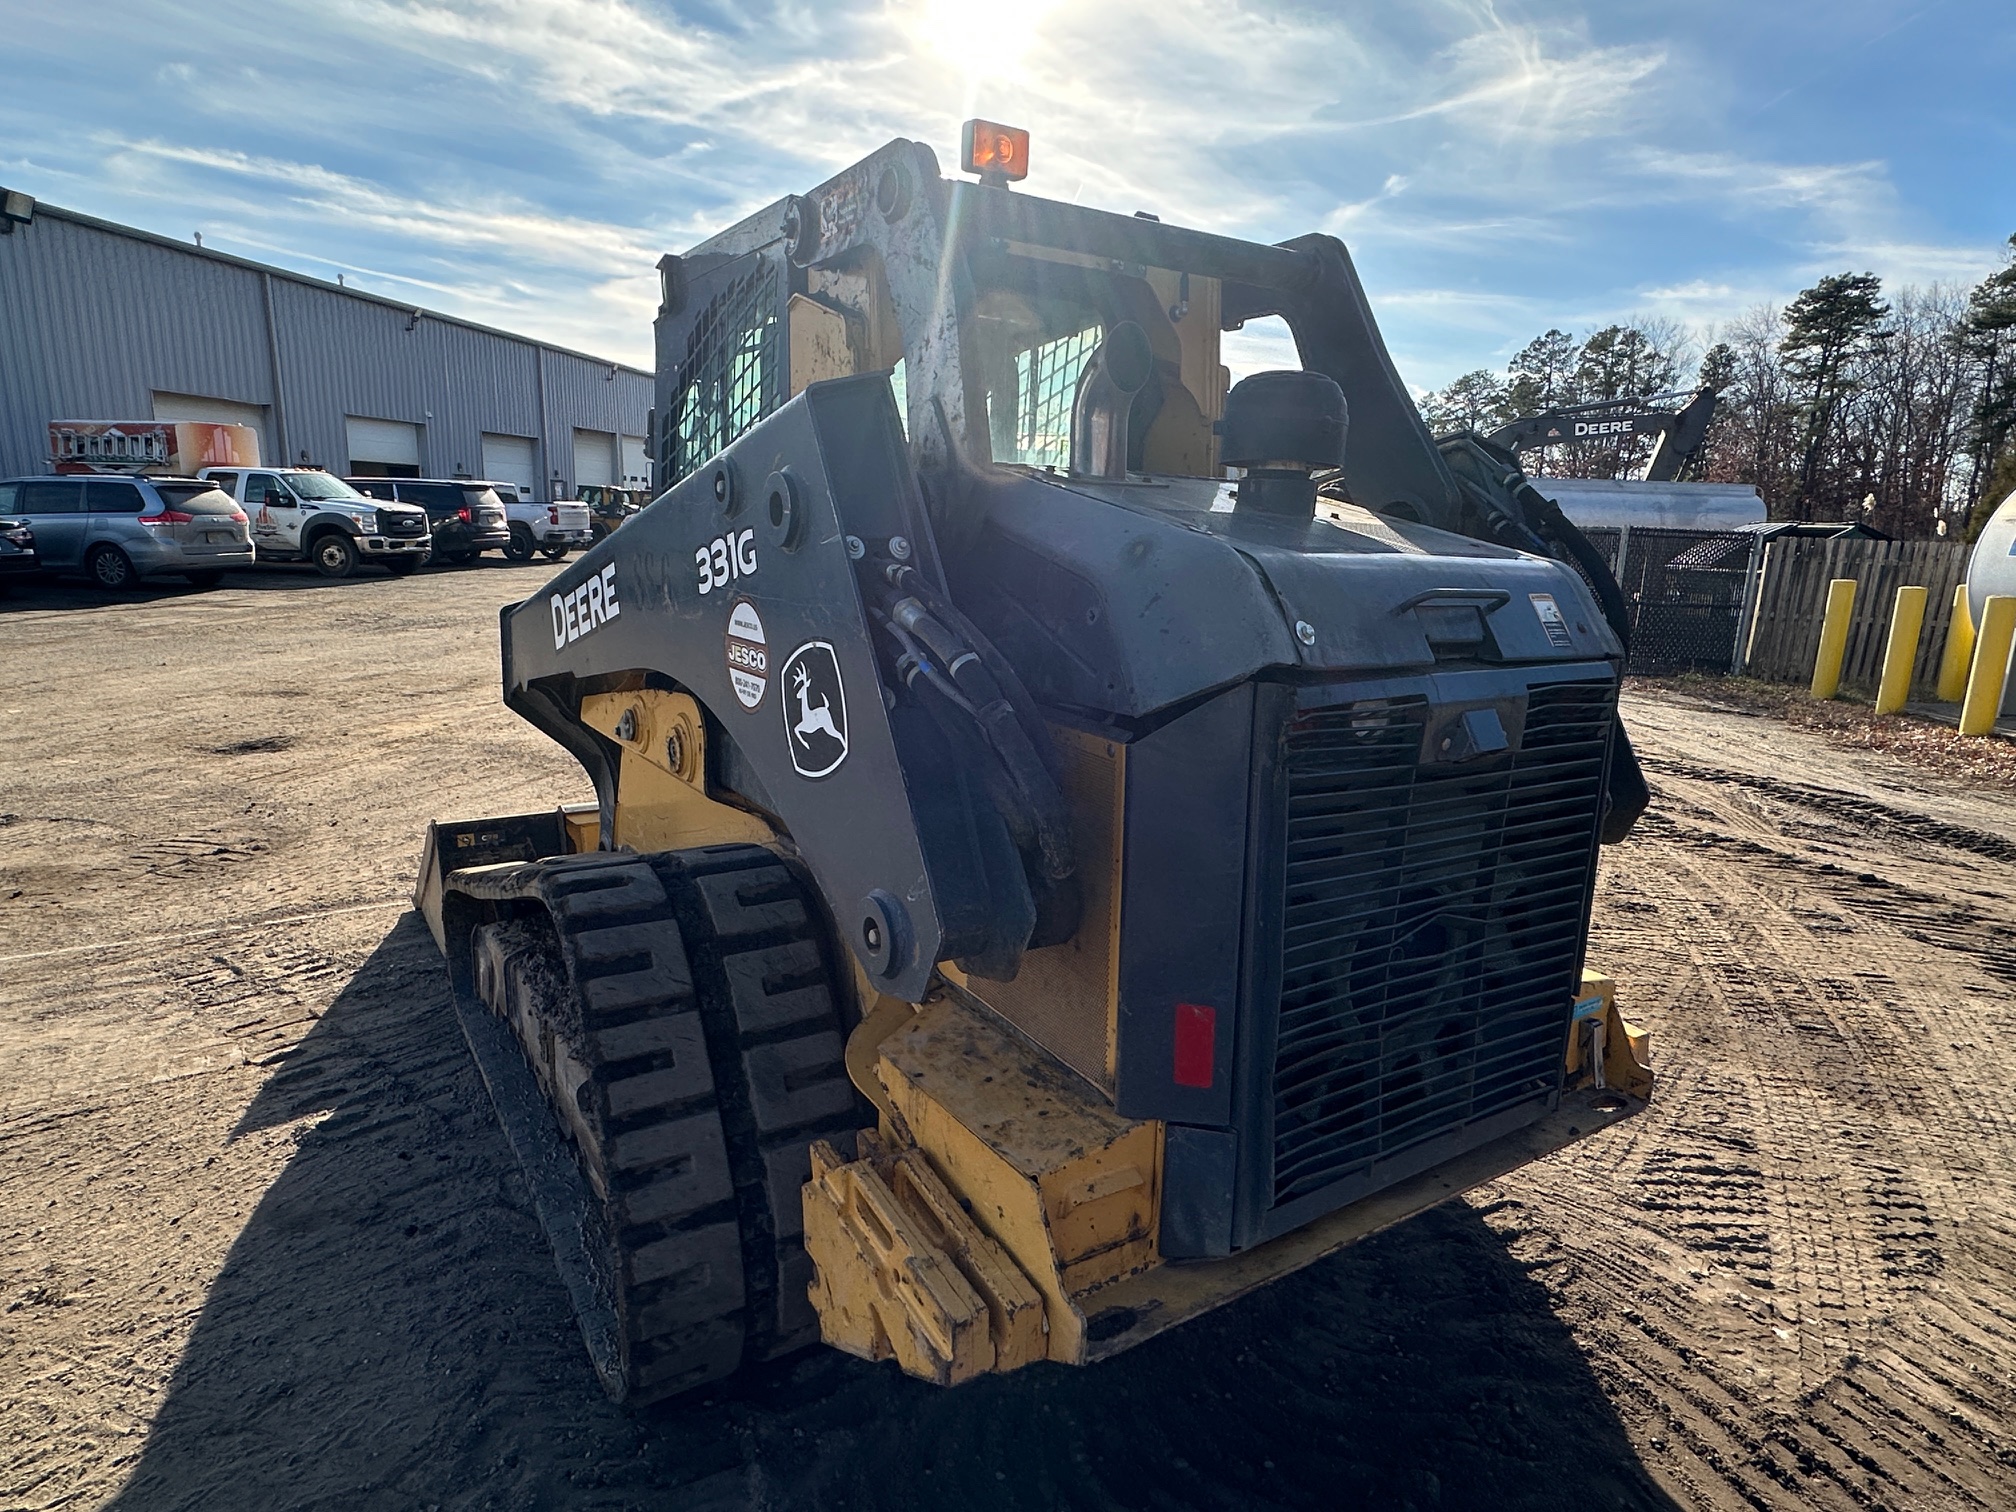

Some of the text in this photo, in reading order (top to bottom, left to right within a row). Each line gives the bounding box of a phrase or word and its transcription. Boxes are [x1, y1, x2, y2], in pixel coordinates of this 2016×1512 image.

[1574, 420, 1633, 436] DEERE
[696, 528, 758, 595] 331G
[551, 562, 620, 650] DEERE
[728, 645, 766, 671] JESCO
